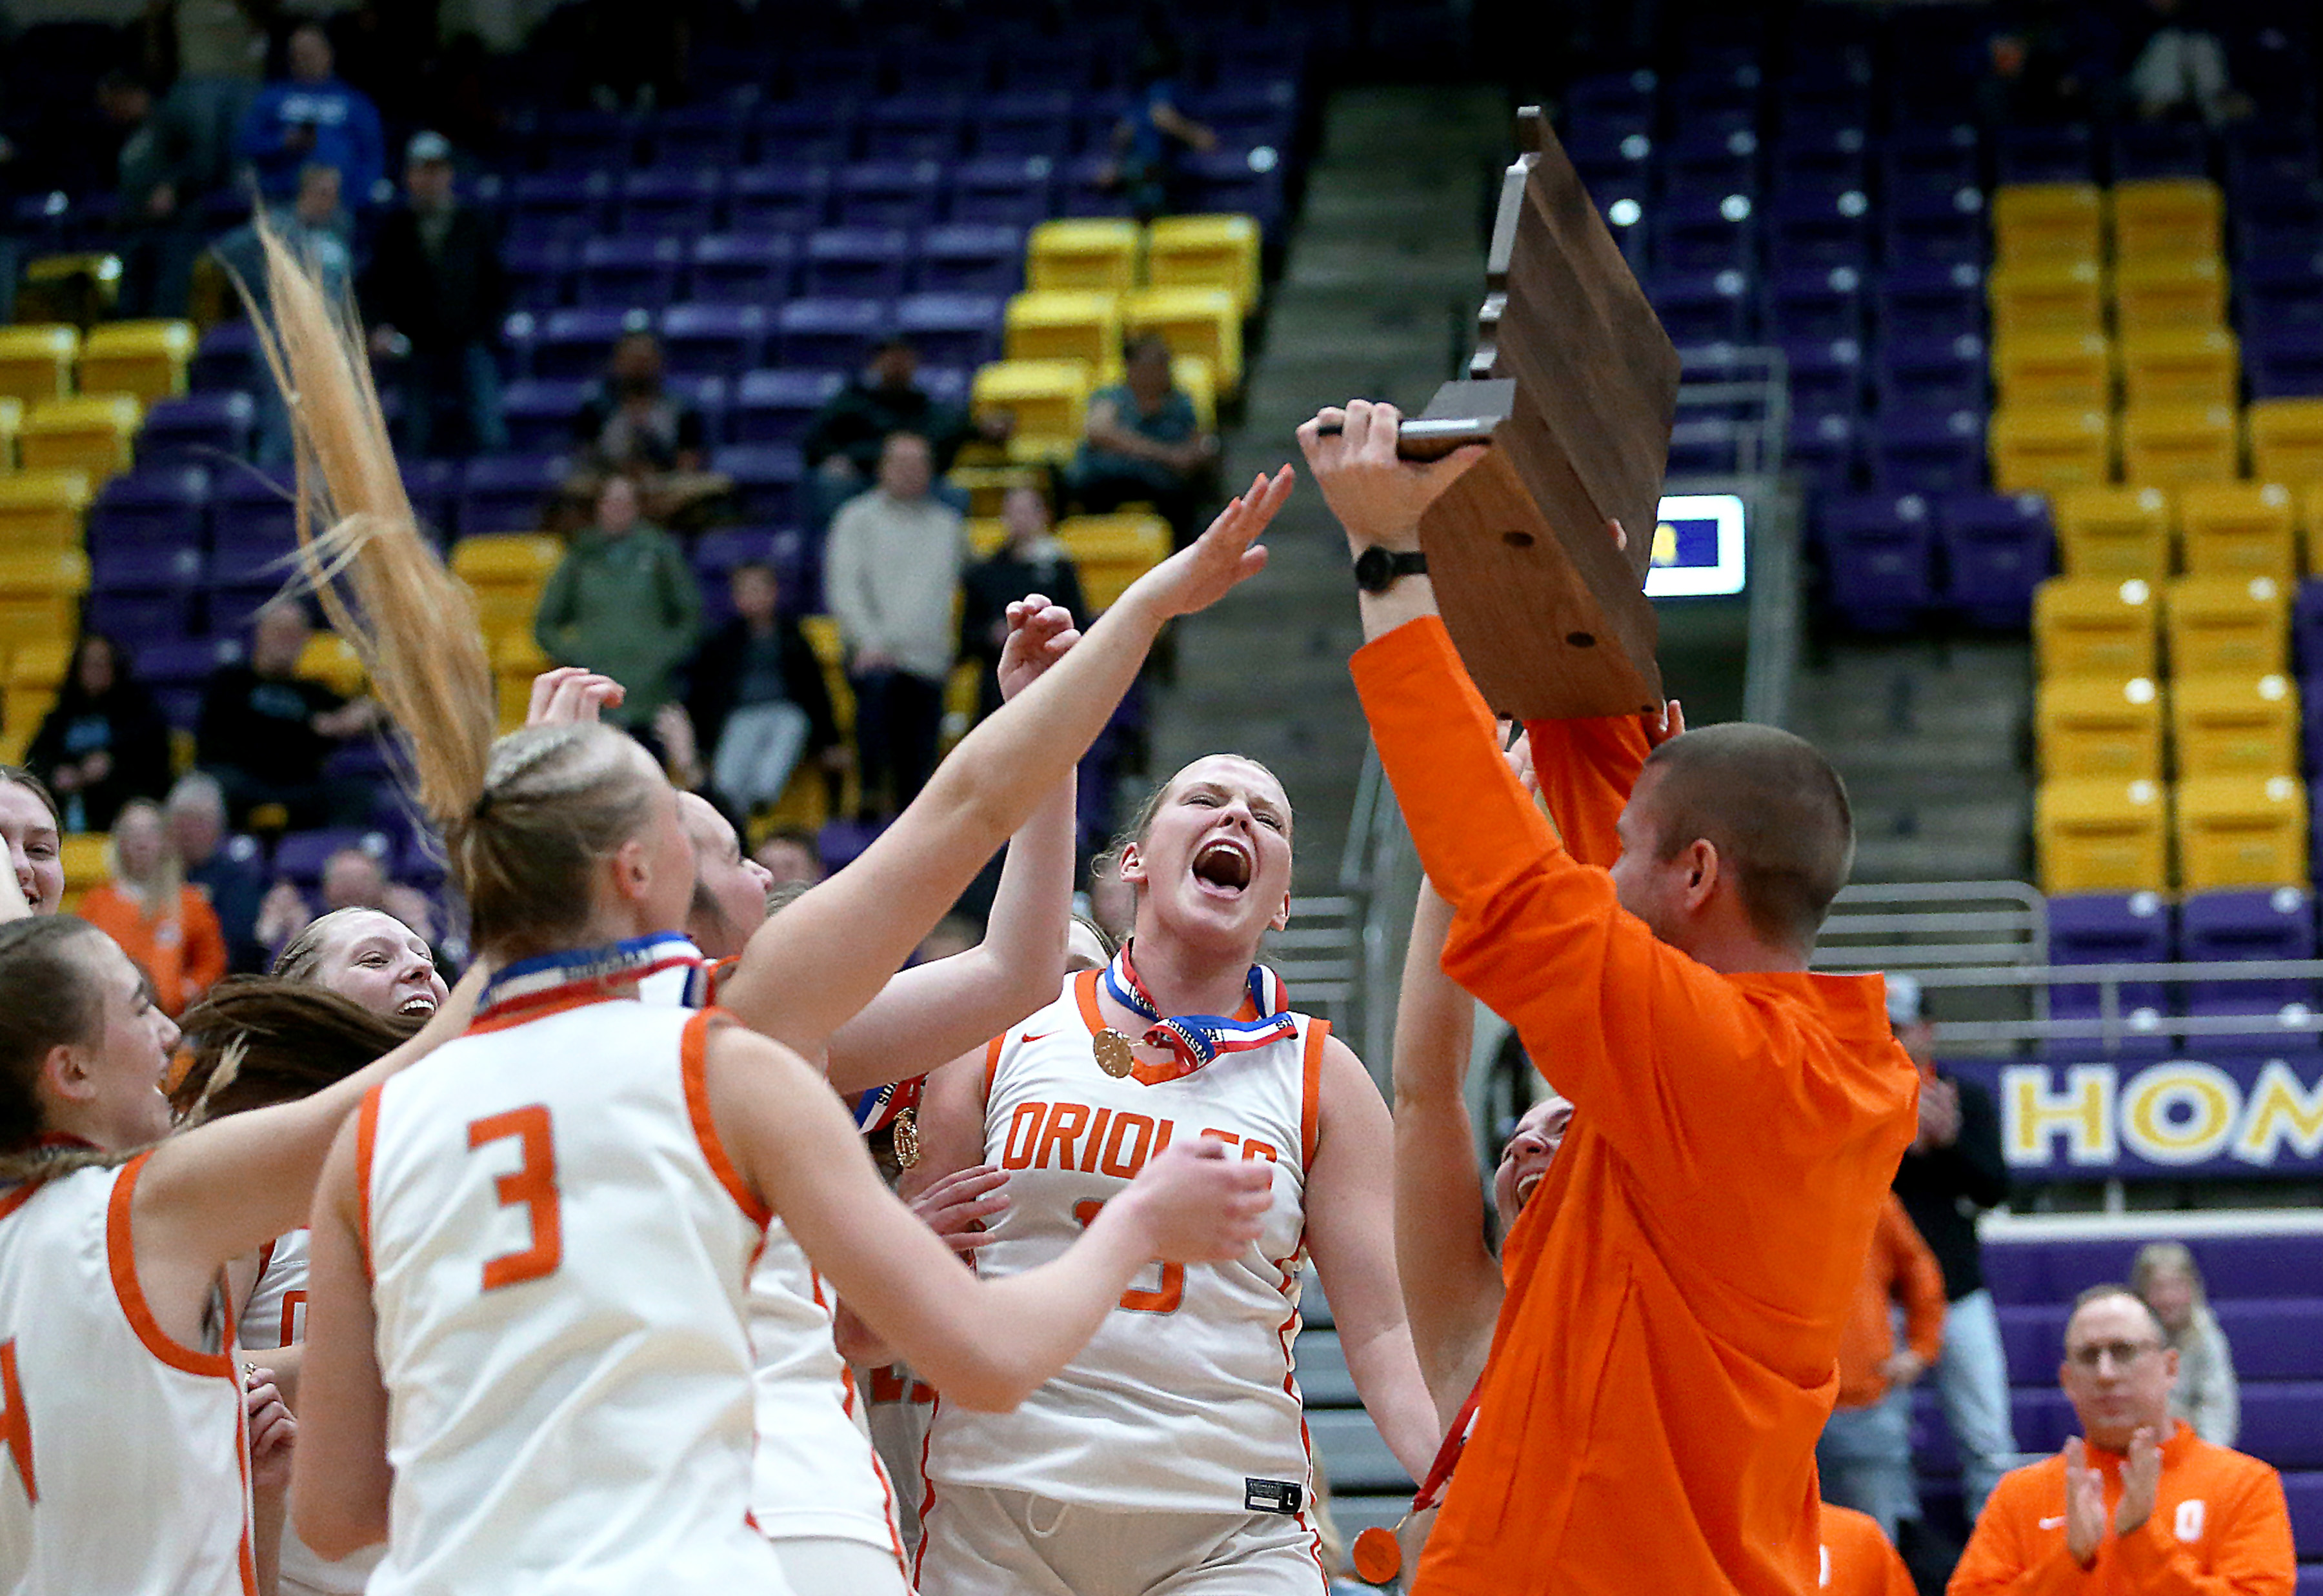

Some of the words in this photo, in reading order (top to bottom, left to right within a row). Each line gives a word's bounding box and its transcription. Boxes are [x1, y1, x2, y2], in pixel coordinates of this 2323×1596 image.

[1002, 1101, 1277, 1191] ORIO
[2001, 1059, 2323, 1166] HOM
[467, 1102, 563, 1293] 3
[1287, 1493, 1293, 1505] L
